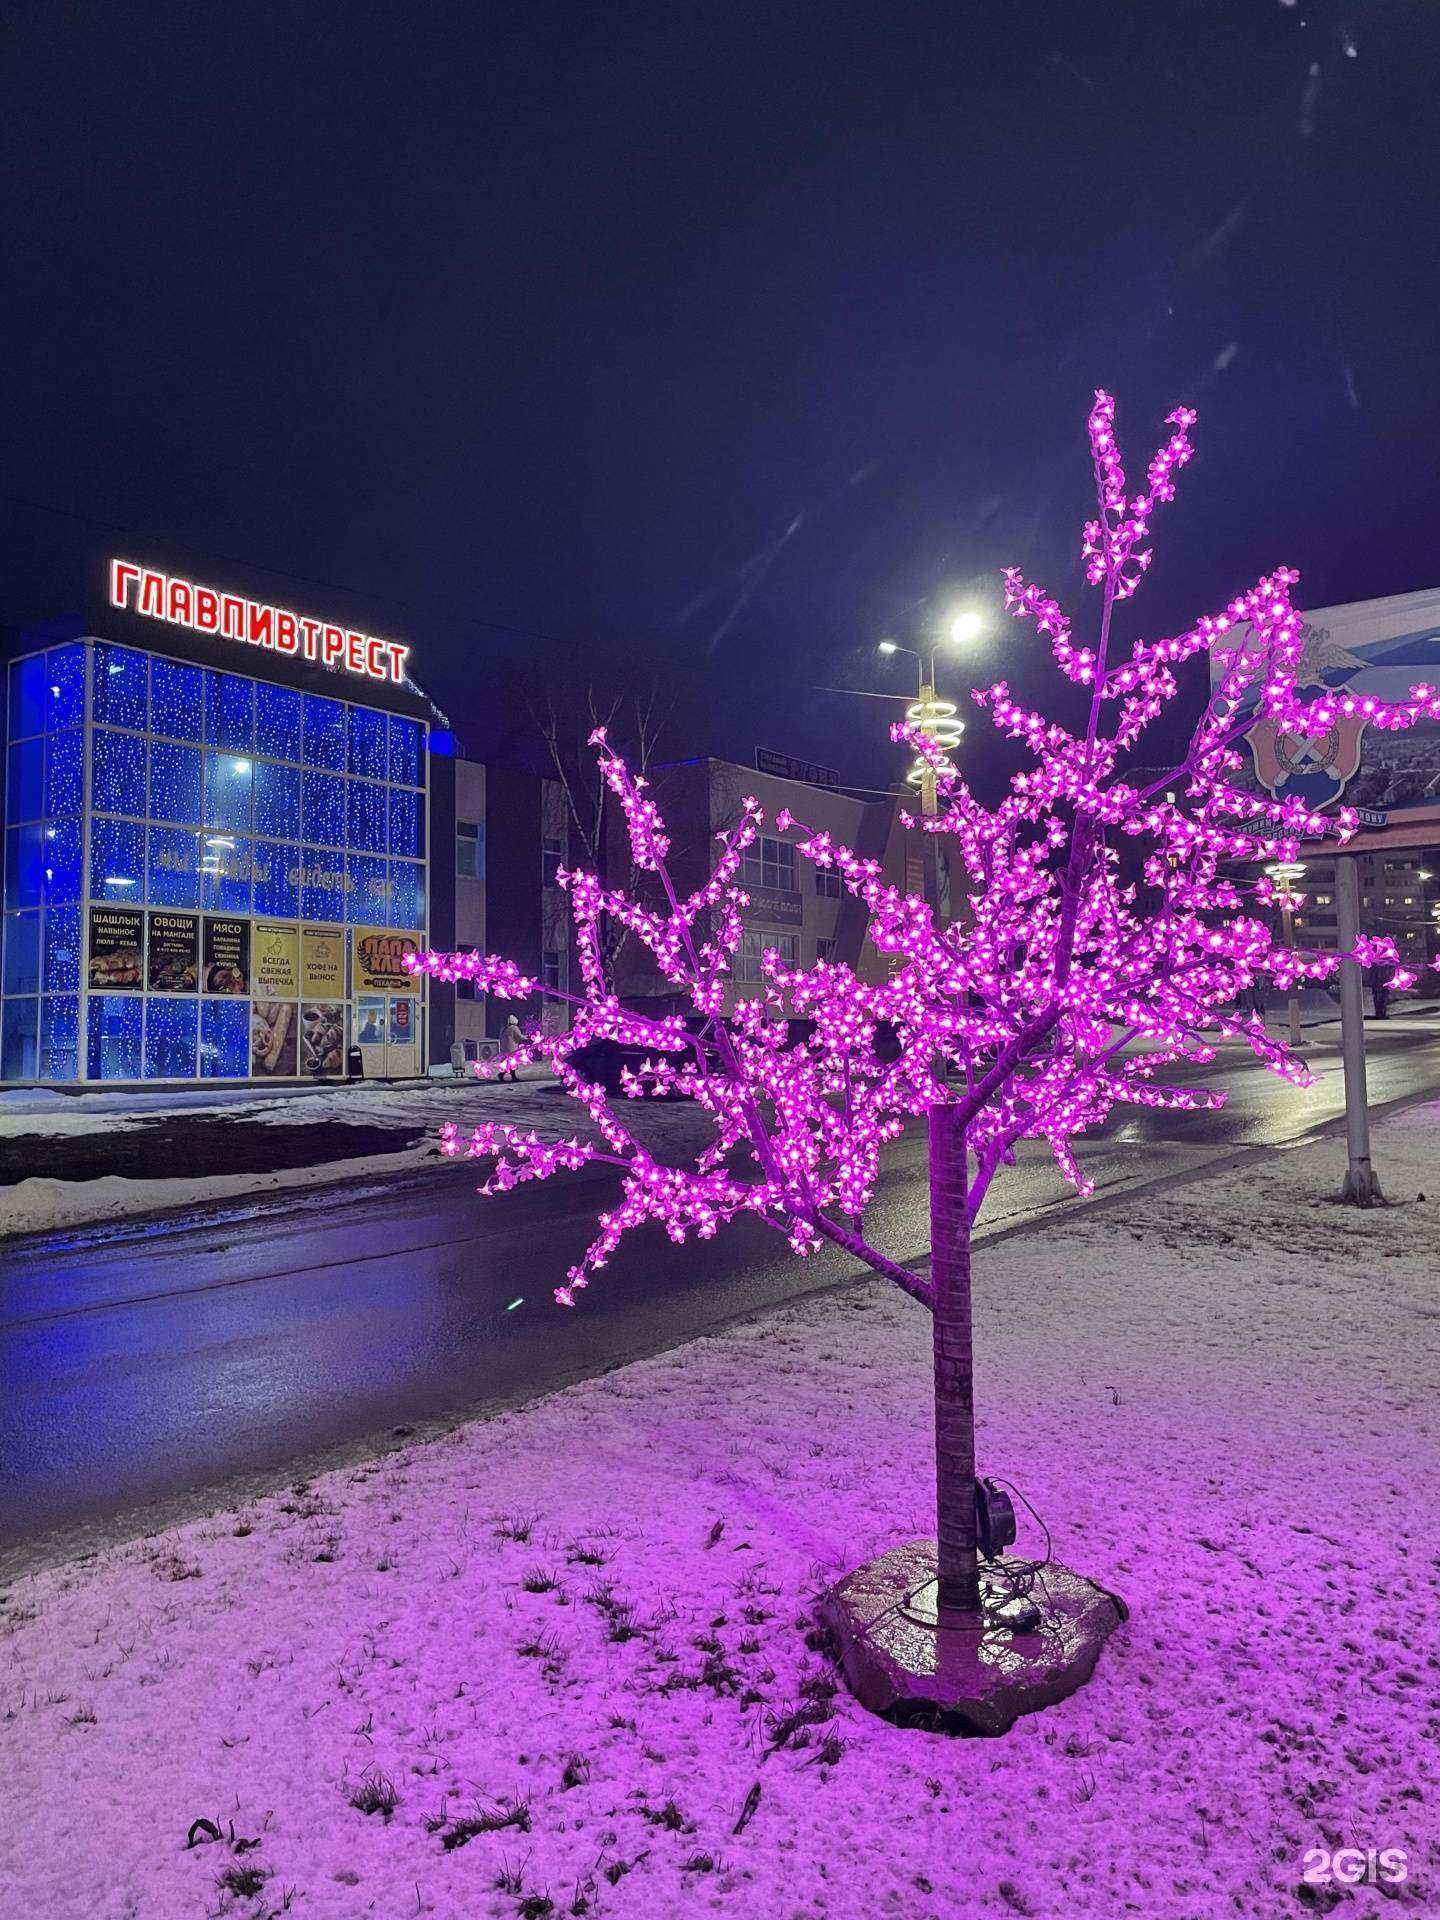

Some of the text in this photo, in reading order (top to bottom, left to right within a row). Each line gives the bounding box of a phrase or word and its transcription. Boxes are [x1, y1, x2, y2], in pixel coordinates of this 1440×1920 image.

[111, 558, 409, 683] ГЛАВПИВТРЕСТ
[93, 914, 141, 926] ШАШЛЫК
[154, 917, 193, 930] ОВОЩИ
[98, 926, 135, 936] НАВЫНОС
[213, 923, 241, 934] МЯСО
[151, 929, 195, 940] НА МАНГАЛЕ
[365, 938, 415, 956] ПАПА
[262, 956, 290, 966] ВСЕГДА
[370, 954, 408, 973] ХЛЕ
[260, 967, 292, 976] СВЕЖАЯ
[306, 962, 338, 972] КОФЕ НА
[258, 976, 294, 986] ВЫПЕЧКА
[309, 973, 336, 981] ВЫНОС
